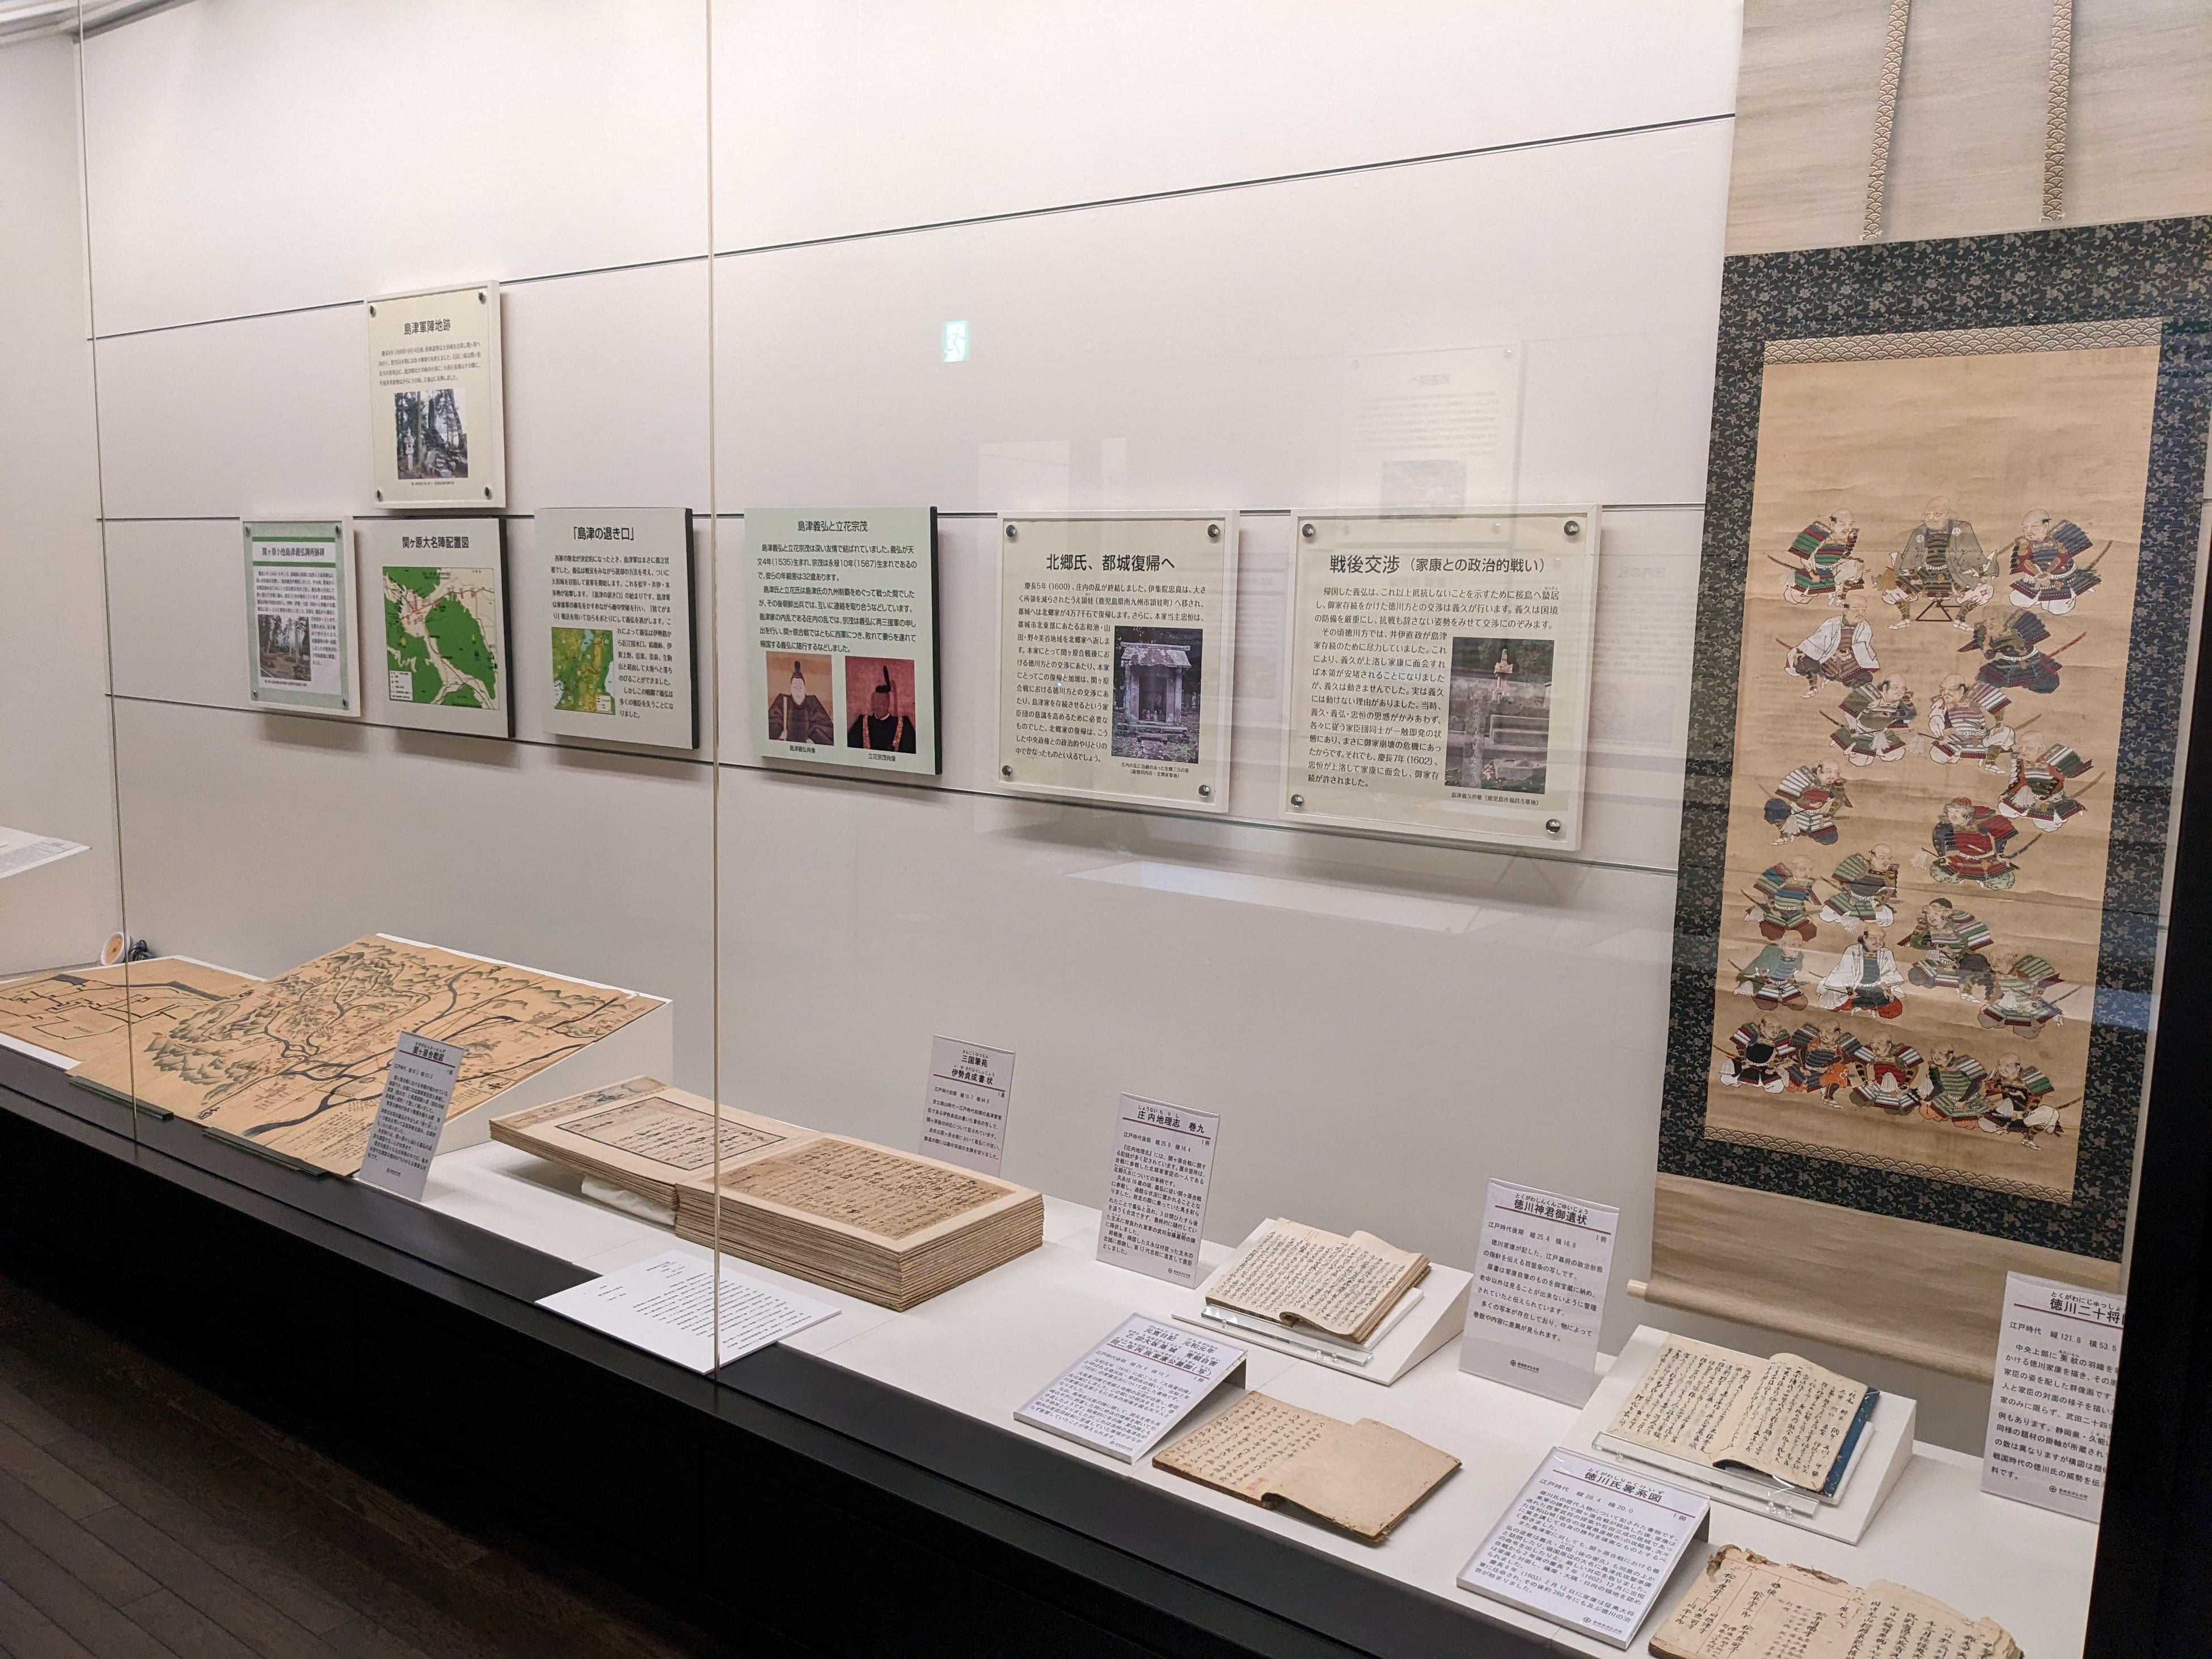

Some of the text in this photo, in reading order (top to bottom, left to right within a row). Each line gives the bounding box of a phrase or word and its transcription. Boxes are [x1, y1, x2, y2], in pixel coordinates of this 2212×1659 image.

[404, 318, 450, 335] 島津軍陣地跡
[797, 520, 868, 531] 島津義弘と立花宗茂
[573, 526, 634, 541] 「島津の退き口」
[402, 536, 470, 549] 関ヶ原大名陣配置図
[1046, 553, 1175, 572] 北郷氏、都城復帰へ
[1329, 554, 1544, 573] 戦後交渉 （家康との政治的戦い）
[1323, 586, 1559, 600] 帰国した義弘は、これ以上抵抗しないことを示すために桜島へ蟄居
[1316, 600, 1558, 615] し、御家存続をかけた徳川方との交渉は義久が行います。義久は国境
[1018, 620, 1110, 632] 都城市北東部にあたる志和池・山
[1314, 614, 1552, 629] の防備を厳重にし、抗戦も辞さない姿勢をみせて交渉にのぞみます。
[1017, 633, 1109, 645] 田・野々美谷地域を北郷家へ返しま
[1322, 628, 1447, 640] その頃徳川方では、井伊直政が島津
[1018, 646, 1109, 658] す。本家にとって関ヶ原合戦後にお
[1313, 641, 1446, 655] 家存続のために尽力していました。これ
[1017, 658, 1109, 671] ける徳川方との交渉にあたり、本家
[1313, 655, 1445, 668] により、義久が上洛し家康に面会すれ
[1017, 672, 1109, 685] にとってこの復帰と加増は、関ヶ原
[1312, 668, 1445, 682] ば本領が安堵されることになりました
[1016, 683, 1109, 698] 合戦における徳川方との交渉にあ
[1311, 681, 1444, 696] が、義久は動きませんでした。実は義久
[1016, 696, 1108, 711] たり、島津家を存続させるという家
[1311, 695, 1441, 710] には動けない理由がありました。当時、
[1016, 709, 1108, 724] 臣団の意識を高めるために必要な
[1310, 707, 1441, 724] 義久・義弘・忠恒の思惑がかみあわず、
[1016, 722, 1108, 737] ものでした。北郷家の復帰は、こう
[1310, 721, 1442, 738] 各々に従う家臣団同士が一触即発の状
[1016, 734, 1107, 749] した中央政権との政治的やりとりの
[1309, 734, 1441, 752] 態にあり、まさに御家崩壊の危機にあっ
[1307, 761, 1439, 780] 忠恒が上洛して家康に面会し、御家存
[1307, 773, 1368, 787] 続が許されました。
[961, 1054, 988, 1067] 三国筆苑
[951, 1068, 993, 1085] 伊勢貞成書状
[1137, 1110, 1205, 1133] 庄内地理志 巻九
[1514, 1198, 1587, 1225] 徳川神君御遺状
[1488, 1221, 1524, 1235] 江戸時代後期
[1479, 1274, 1597, 1311] 老中以外は見ることが出来ないように管理
[1477, 1286, 1564, 1316] されていたと伝えられています。
[2050, 1290, 2125, 1311] とくがわにじゅっしょ
[1481, 1300, 1592, 1337] 多くの写本が存在しており、物によって
[2049, 1297, 2125, 1325] 徳川二十将
[2009, 1321, 2041, 1335] 江戸時代
[1991, 1466, 2018, 1480] 料です。
[1993, 1451, 2100, 1487] 戦国時代の徳川氏の威勢を伝
[1539, 1478, 1569, 1492] 江戸時代
